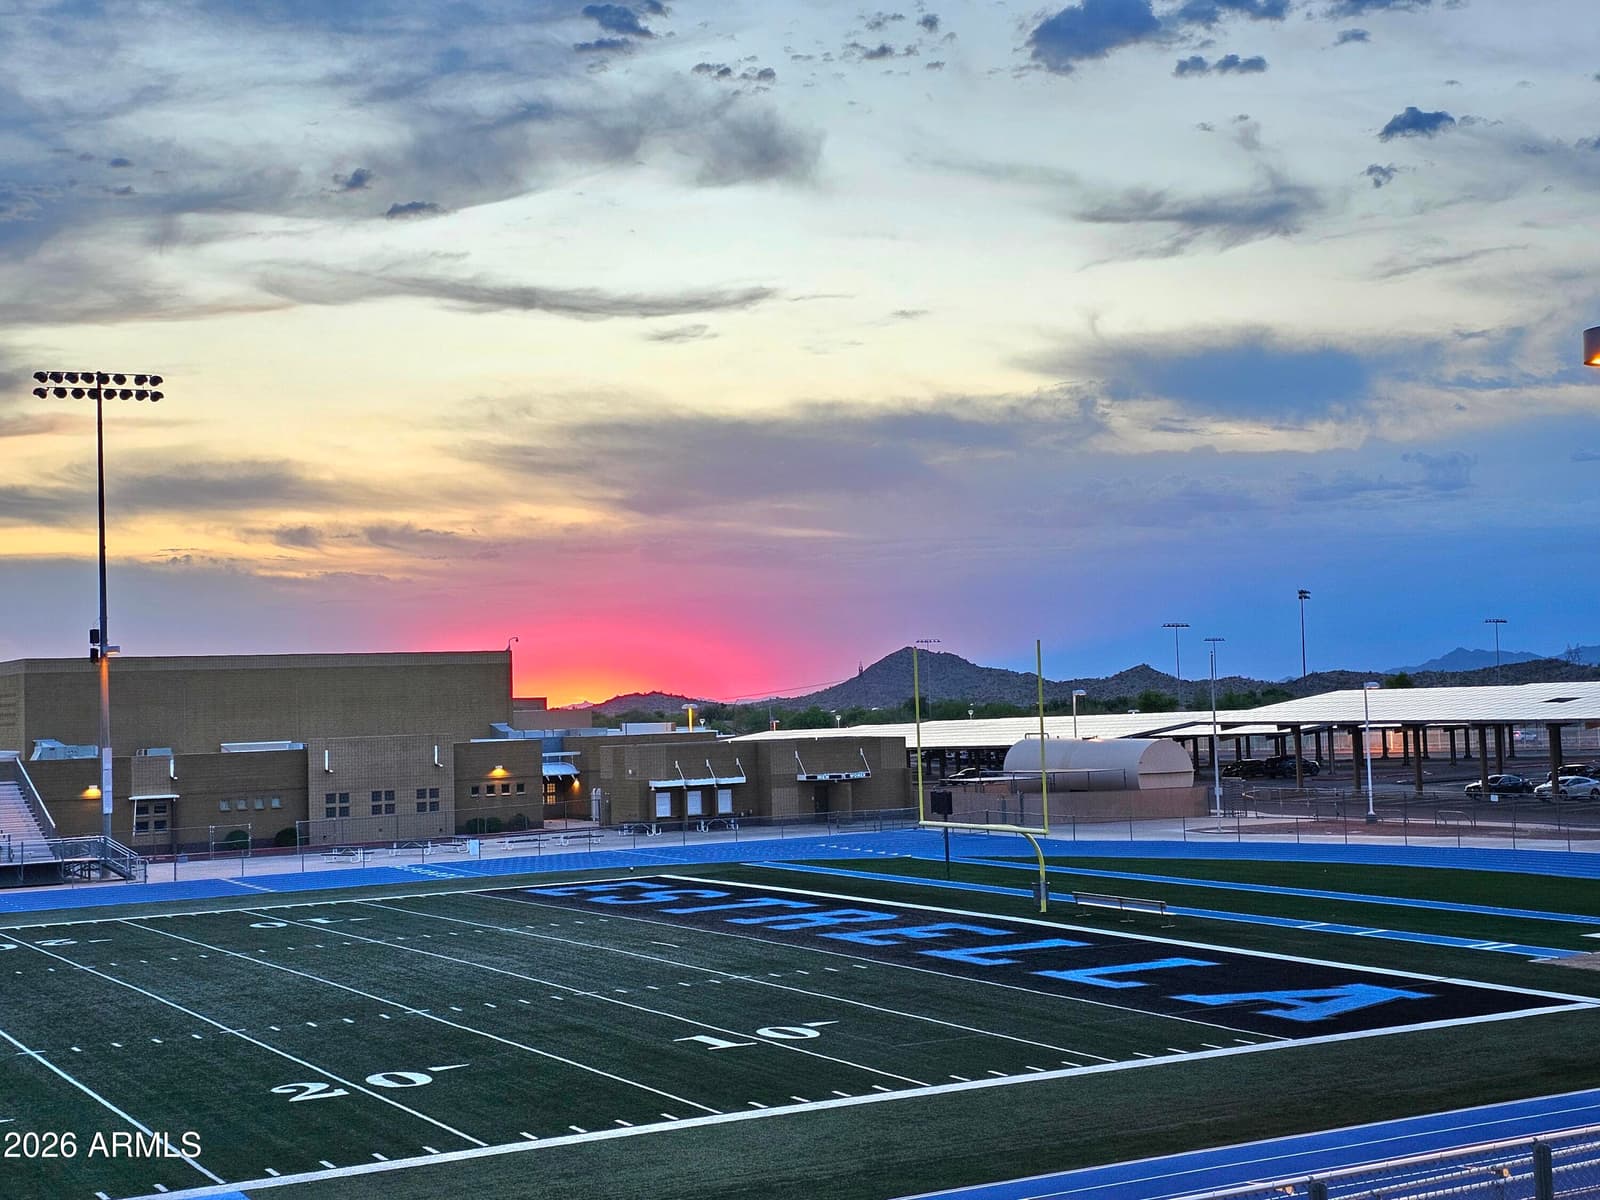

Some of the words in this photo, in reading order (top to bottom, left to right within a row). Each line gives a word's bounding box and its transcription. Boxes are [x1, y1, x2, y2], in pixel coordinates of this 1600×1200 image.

[526, 881, 1436, 1022] ESTRELLA
[673, 1026, 821, 1050] 10
[269, 1071, 433, 1102] 20
